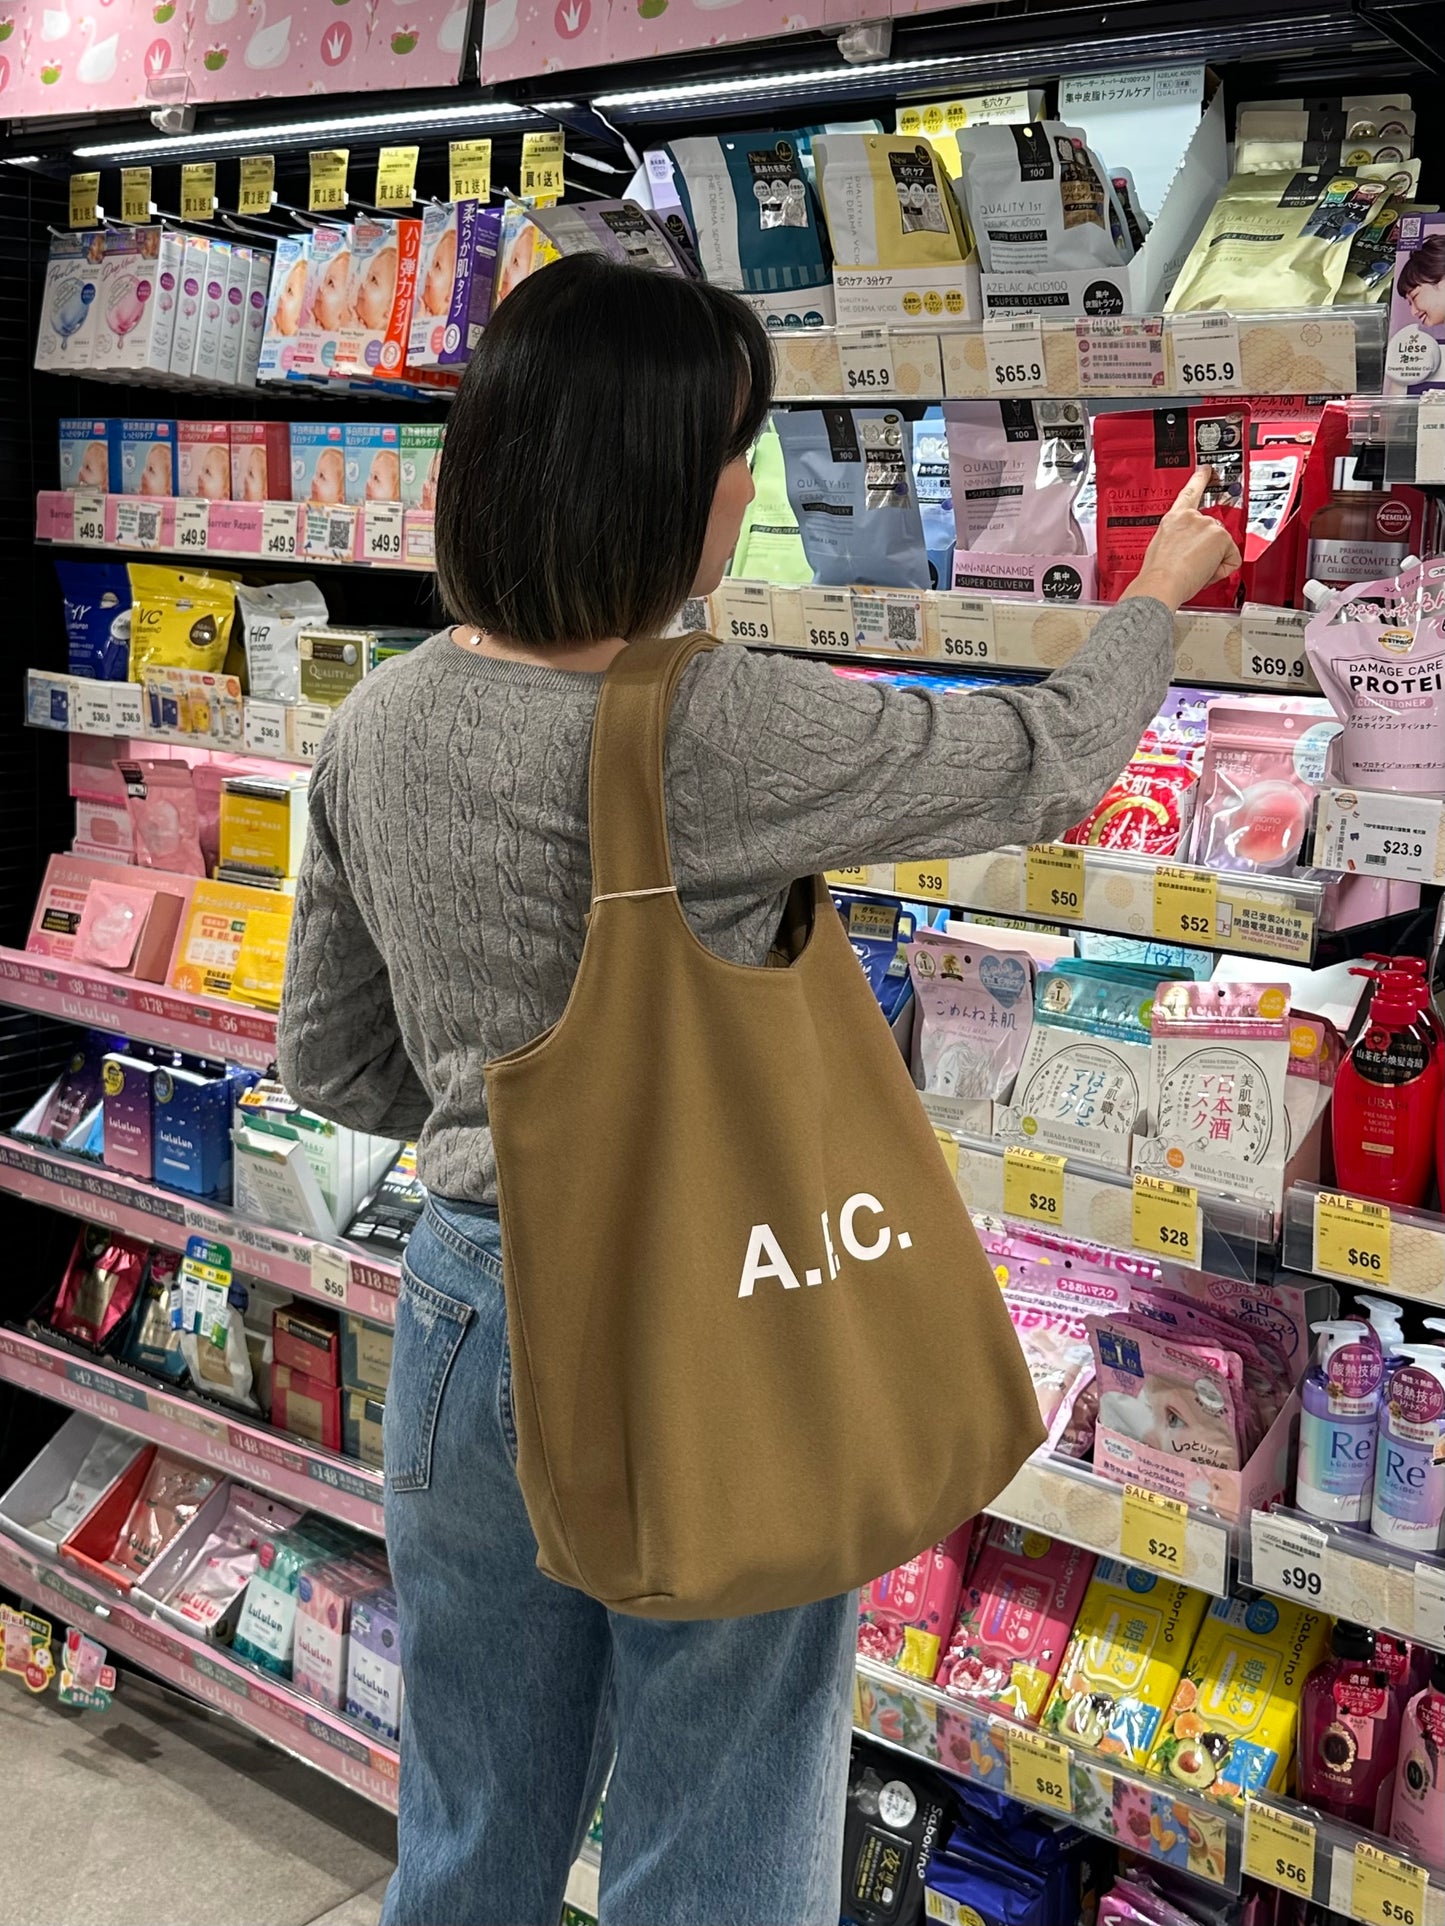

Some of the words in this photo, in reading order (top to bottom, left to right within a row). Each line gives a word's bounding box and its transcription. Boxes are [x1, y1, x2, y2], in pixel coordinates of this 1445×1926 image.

[980, 96, 1012, 108] 毛穴ケア
[1065, 86, 1151, 104] 集中皮脂トラブルケア
[525, 171, 559, 188] 買1送1
[899, 167, 925, 176] 毛穴ケア
[1030, 168, 1045, 177] 100
[314, 188, 343, 204] 買1送1
[380, 184, 410, 200] 買1送1
[454, 179, 487, 196] 買1送1
[184, 198, 212, 213] 買1送1
[981, 201, 1026, 214] QUALITY
[1009, 231, 1045, 241] DELIVERY
[453, 200, 477, 318] 柔らか肌タイプ
[398, 224, 421, 335] ハリ弾力タイプ
[986, 281, 1023, 292] AZELAIC
[1023, 295, 1065, 305] DELIVERY
[1095, 289, 1109, 298] 集中
[1085, 299, 1123, 308] 皮脂トラブル
[1398, 342, 1427, 353] Liese
[847, 368, 890, 388] $45.9
[995, 363, 1041, 384] $65.9
[1191, 362, 1234, 383] $65.9
[1015, 430, 1029, 439] 100
[839, 451, 853, 460] 100
[1164, 455, 1180, 465] 100
[963, 460, 1007, 473] QUALITY
[1107, 487, 1159, 498] QUALITY
[233, 519, 257, 531] Repair
[1376, 512, 1412, 522] PREMIUM
[79, 523, 104, 540] $49.9
[181, 528, 207, 546] $49.9
[267, 535, 295, 553] $49.9
[371, 534, 400, 553] $49.9
[1339, 546, 1373, 555] PREMIUM
[955, 563, 1035, 576] NMN+NIACINAMIDE
[1311, 554, 1341, 565] VITAL
[1342, 555, 1350, 565] C
[1351, 555, 1402, 569] COMPLEX
[1052, 571, 1070, 581] 集中
[1327, 566, 1363, 576] CELLULOSE
[1364, 567, 1383, 576] MASK
[986, 577, 1031, 589] DELIVERY
[1043, 581, 1081, 593] エイジング
[137, 608, 163, 625] VC
[250, 626, 270, 641] HA
[730, 620, 769, 640] $65.9
[813, 628, 849, 647] $65.9
[309, 664, 346, 680] QUALITY
[1251, 654, 1305, 679] $69.9
[1349, 662, 1405, 678] DAMAGE
[1407, 658, 1444, 676] CARE
[1356, 696, 1427, 709] CONDITIONER
[91, 711, 111, 724] $36.9
[122, 711, 141, 724] $36.9
[1350, 714, 1393, 722] ダメージケア
[261, 725, 280, 739] $36.9
[1027, 844, 1055, 855] SALE
[1382, 839, 1423, 857] $23.9
[1155, 866, 1186, 879] SALE
[918, 873, 943, 891] $39
[1051, 887, 1077, 907] $50
[1180, 914, 1209, 933] $52
[1242, 909, 1302, 929] 現已安裝24小時
[1233, 918, 1309, 942] 閉路電視及錄影系統
[67, 978, 86, 996] $38
[61, 996, 122, 1029] LuLuLun
[139, 994, 164, 1016] $178
[218, 1013, 239, 1034] $56
[936, 1000, 1018, 1032] ごめんね素肌
[207, 1033, 276, 1064] LuLuLun
[1095, 1076, 1124, 1129] 美肌職人
[1190, 1073, 1216, 1132] マスク
[1208, 1073, 1236, 1142] 日本酒
[1237, 1073, 1256, 1134] 美肌職人
[1362, 1110, 1397, 1121] PREMIUM
[108, 1116, 143, 1137] LuLuLun
[159, 1129, 194, 1151] LuLuLun
[1042, 1131, 1102, 1149] BIHADA-SYOKUNIN
[1006, 1145, 1035, 1158] SALE
[1134, 1174, 1165, 1190] SALE
[1189, 1162, 1255, 1184] BIHADA-SYOKUNIN
[83, 1177, 103, 1195] $85
[59, 1189, 119, 1223] LuLuLun
[134, 1192, 153, 1210] $85
[1029, 1193, 1056, 1213] $28
[1319, 1193, 1353, 1210] SALE
[185, 1211, 204, 1229] $98
[237, 1228, 256, 1246] $98
[1159, 1225, 1189, 1247] $28
[1347, 1247, 1381, 1271] $66
[354, 1268, 382, 1289] $118
[324, 1278, 345, 1298] $59
[1059, 1280, 1115, 1299] うるおいマスク
[1331, 1360, 1382, 1378] 酸熱技術
[74, 1369, 93, 1388] $42
[1340, 1377, 1374, 1387] トリートメント
[59, 1380, 120, 1419] LuLuLun
[1391, 1380, 1443, 1406] 酸熱技術
[233, 1433, 259, 1455] $148
[1330, 1430, 1371, 1462] Re
[205, 1442, 273, 1482] LuLuLun
[1385, 1448, 1426, 1489] Re
[312, 1465, 339, 1486] $148
[1124, 1483, 1156, 1505] SALE
[1148, 1538, 1178, 1563] $22
[1282, 1566, 1323, 1596] $99
[247, 1603, 284, 1634] LuLuLun
[297, 1635, 333, 1666] LuLuLun
[1283, 1613, 1320, 1688] Saborino
[352, 1668, 391, 1700] LuLuLun
[1349, 1673, 1370, 1686] 濃密
[178, 1666, 245, 1716] LuLuLun
[1009, 1727, 1039, 1746] SALE
[1035, 1777, 1064, 1799] $82
[1249, 1802, 1283, 1824] SALE
[916, 1803, 944, 1879] Saborino
[1356, 1843, 1391, 1864] SALE
[1275, 1857, 1307, 1884] $56
[1382, 1899, 1415, 1926] $56
